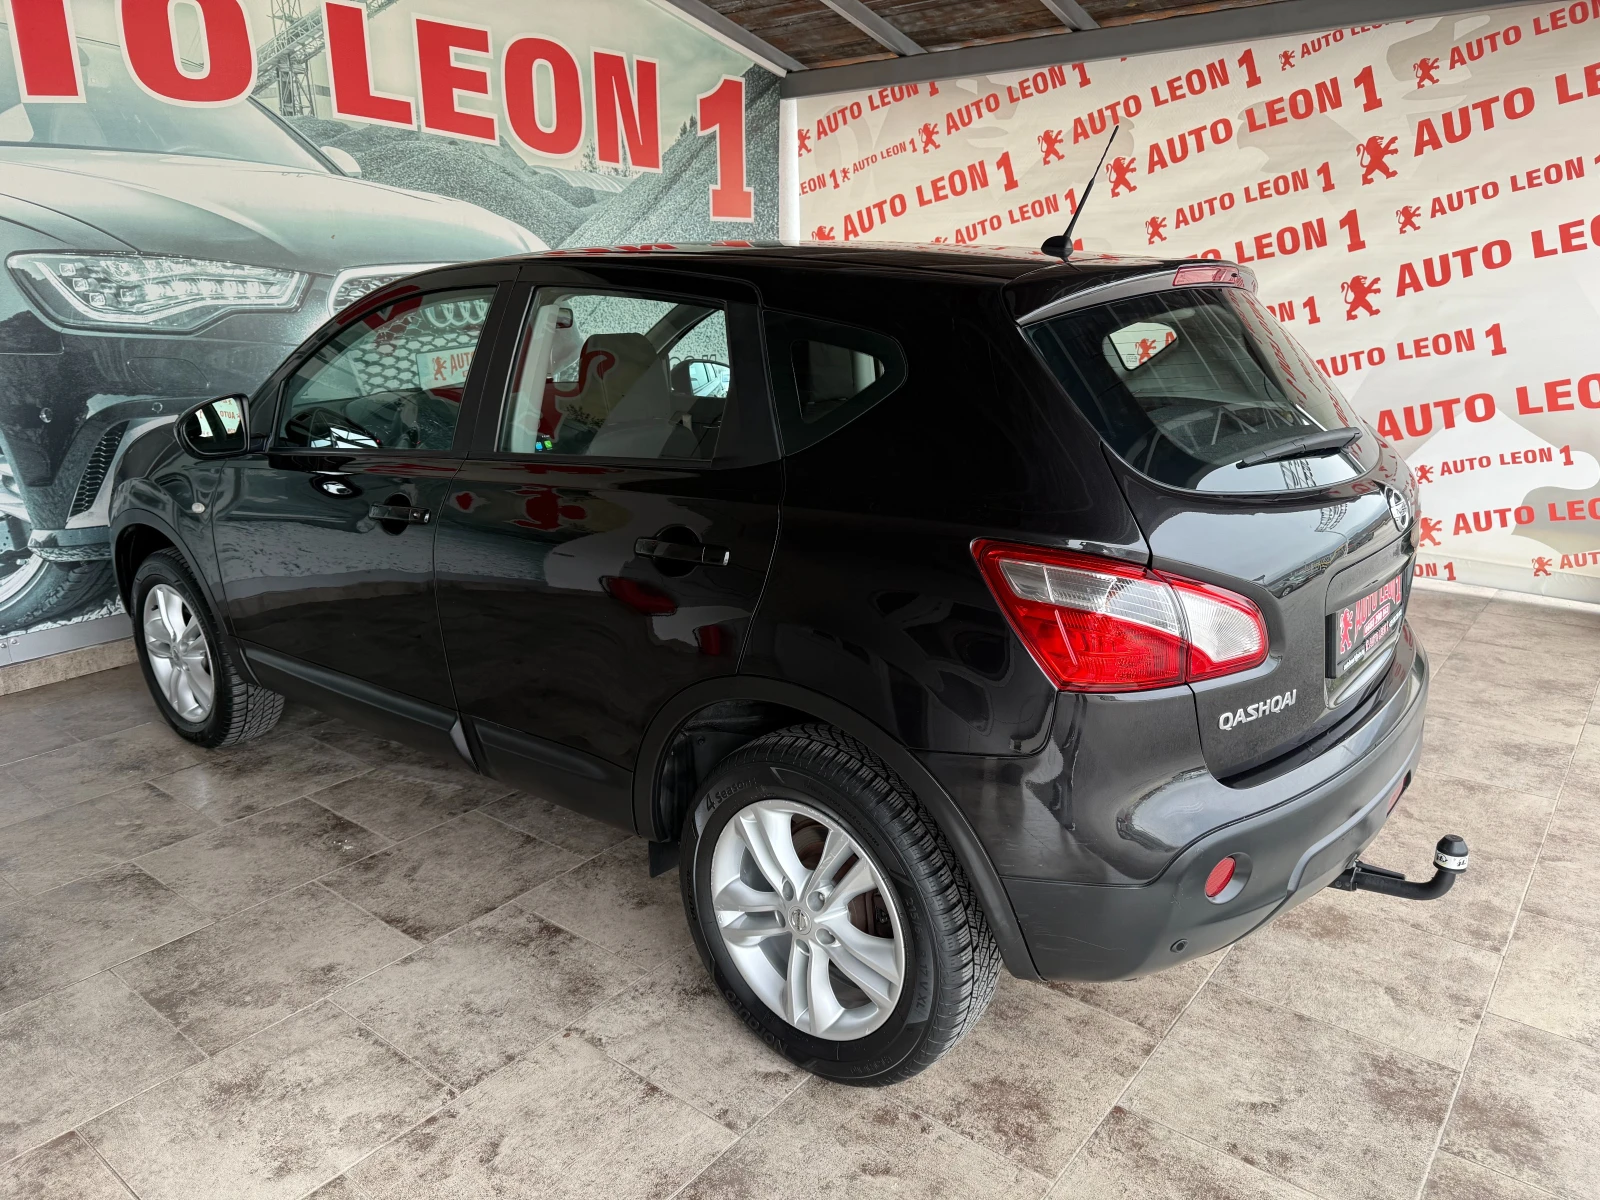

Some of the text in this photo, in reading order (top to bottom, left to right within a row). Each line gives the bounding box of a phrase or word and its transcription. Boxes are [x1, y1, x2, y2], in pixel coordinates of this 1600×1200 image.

[1300, 28, 1344, 59] AUTO
[1449, 25, 1522, 70] AUTO
[323, 0, 662, 171] LEON
[699, 77, 753, 219] 1
[816, 101, 863, 141] AUTO
[867, 83, 920, 112] LEON
[945, 62, 1091, 136] AUTO LEON 1
[1072, 48, 1262, 144] AUTO LEON 1
[1147, 65, 1383, 175] AUTO LEON 1
[1413, 86, 1536, 157] AUTO
[799, 168, 841, 197] EON 1
[852, 137, 918, 174] AUTO LEON 1
[842, 151, 1019, 241] AUTO LEON 1
[954, 187, 1079, 245] AUTO LEON 1
[1173, 161, 1336, 230] AUTO LEON 1
[1430, 156, 1585, 219] AUTO LEON
[1234, 208, 1367, 265] LEON 1
[1396, 239, 1513, 298] AUTO
[1302, 295, 1321, 325] 1
[1316, 322, 1508, 379] AUTO LEON 1
[1376, 391, 1496, 443] AUTO
[1439, 444, 1575, 477] AUTO LEON 1
[1452, 504, 1536, 537] AUTO
[1443, 561, 1457, 582] 1
[1218, 688, 1298, 731] QASHQAI
